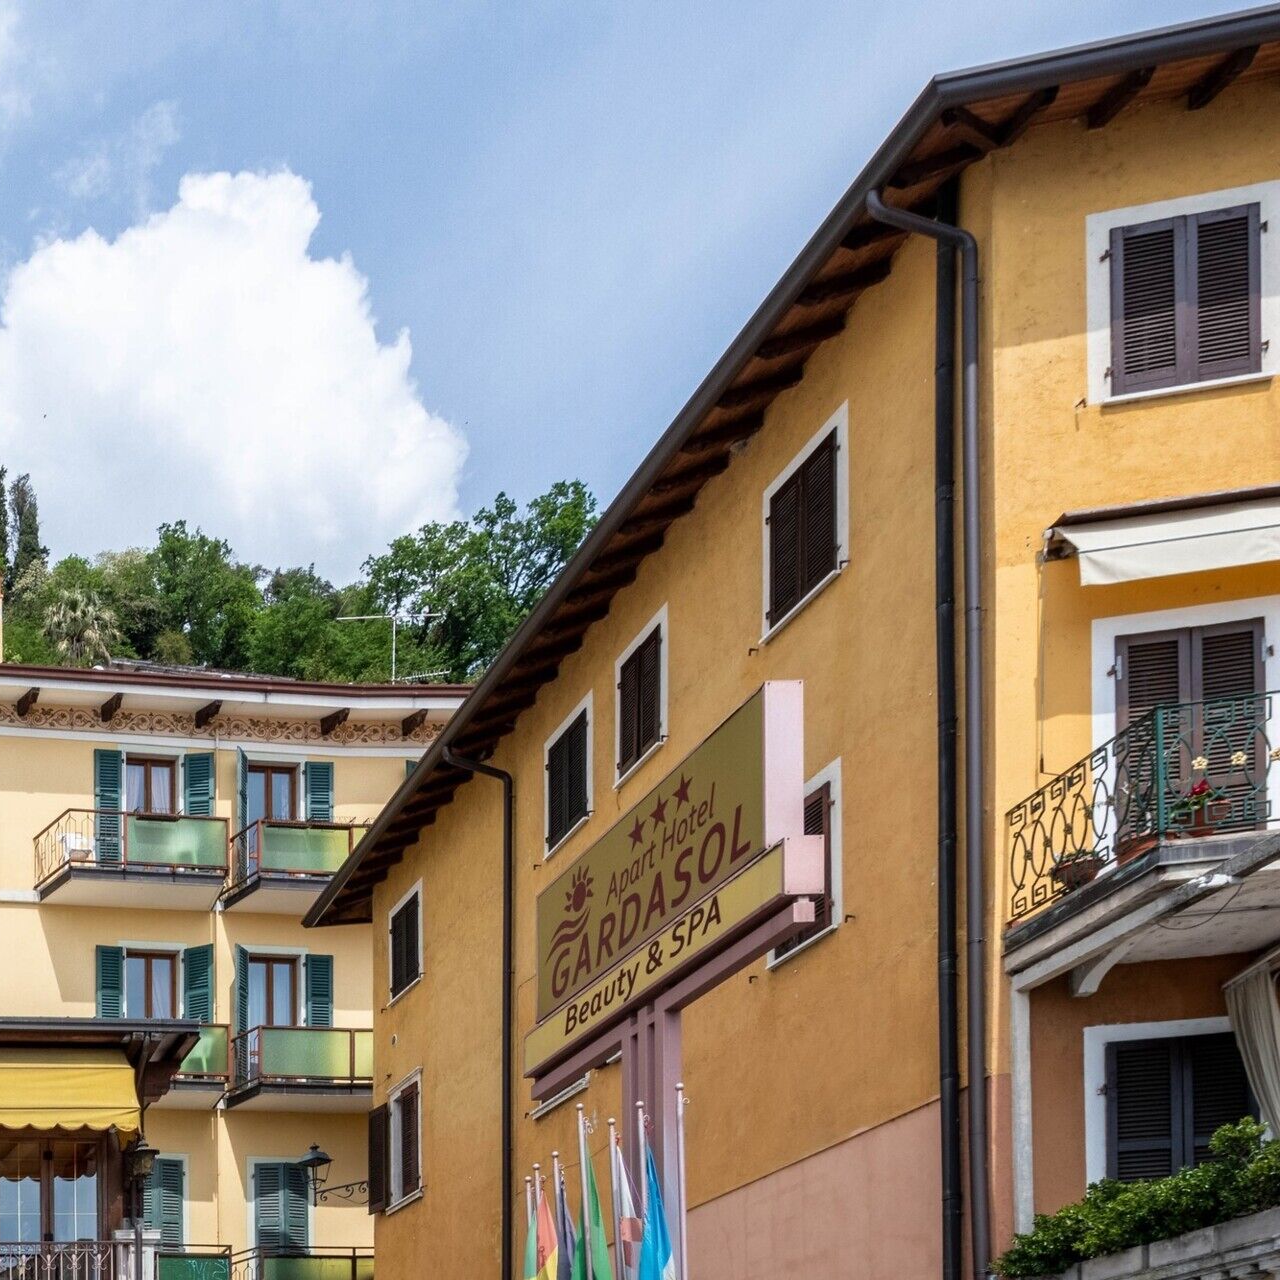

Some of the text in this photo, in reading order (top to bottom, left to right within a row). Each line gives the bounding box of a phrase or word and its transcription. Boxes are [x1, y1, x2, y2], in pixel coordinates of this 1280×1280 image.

[550, 804, 753, 1000] GARDASOL
[606, 782, 717, 907] Apart Hotel
[564, 895, 723, 1036] Beauty & SPA
